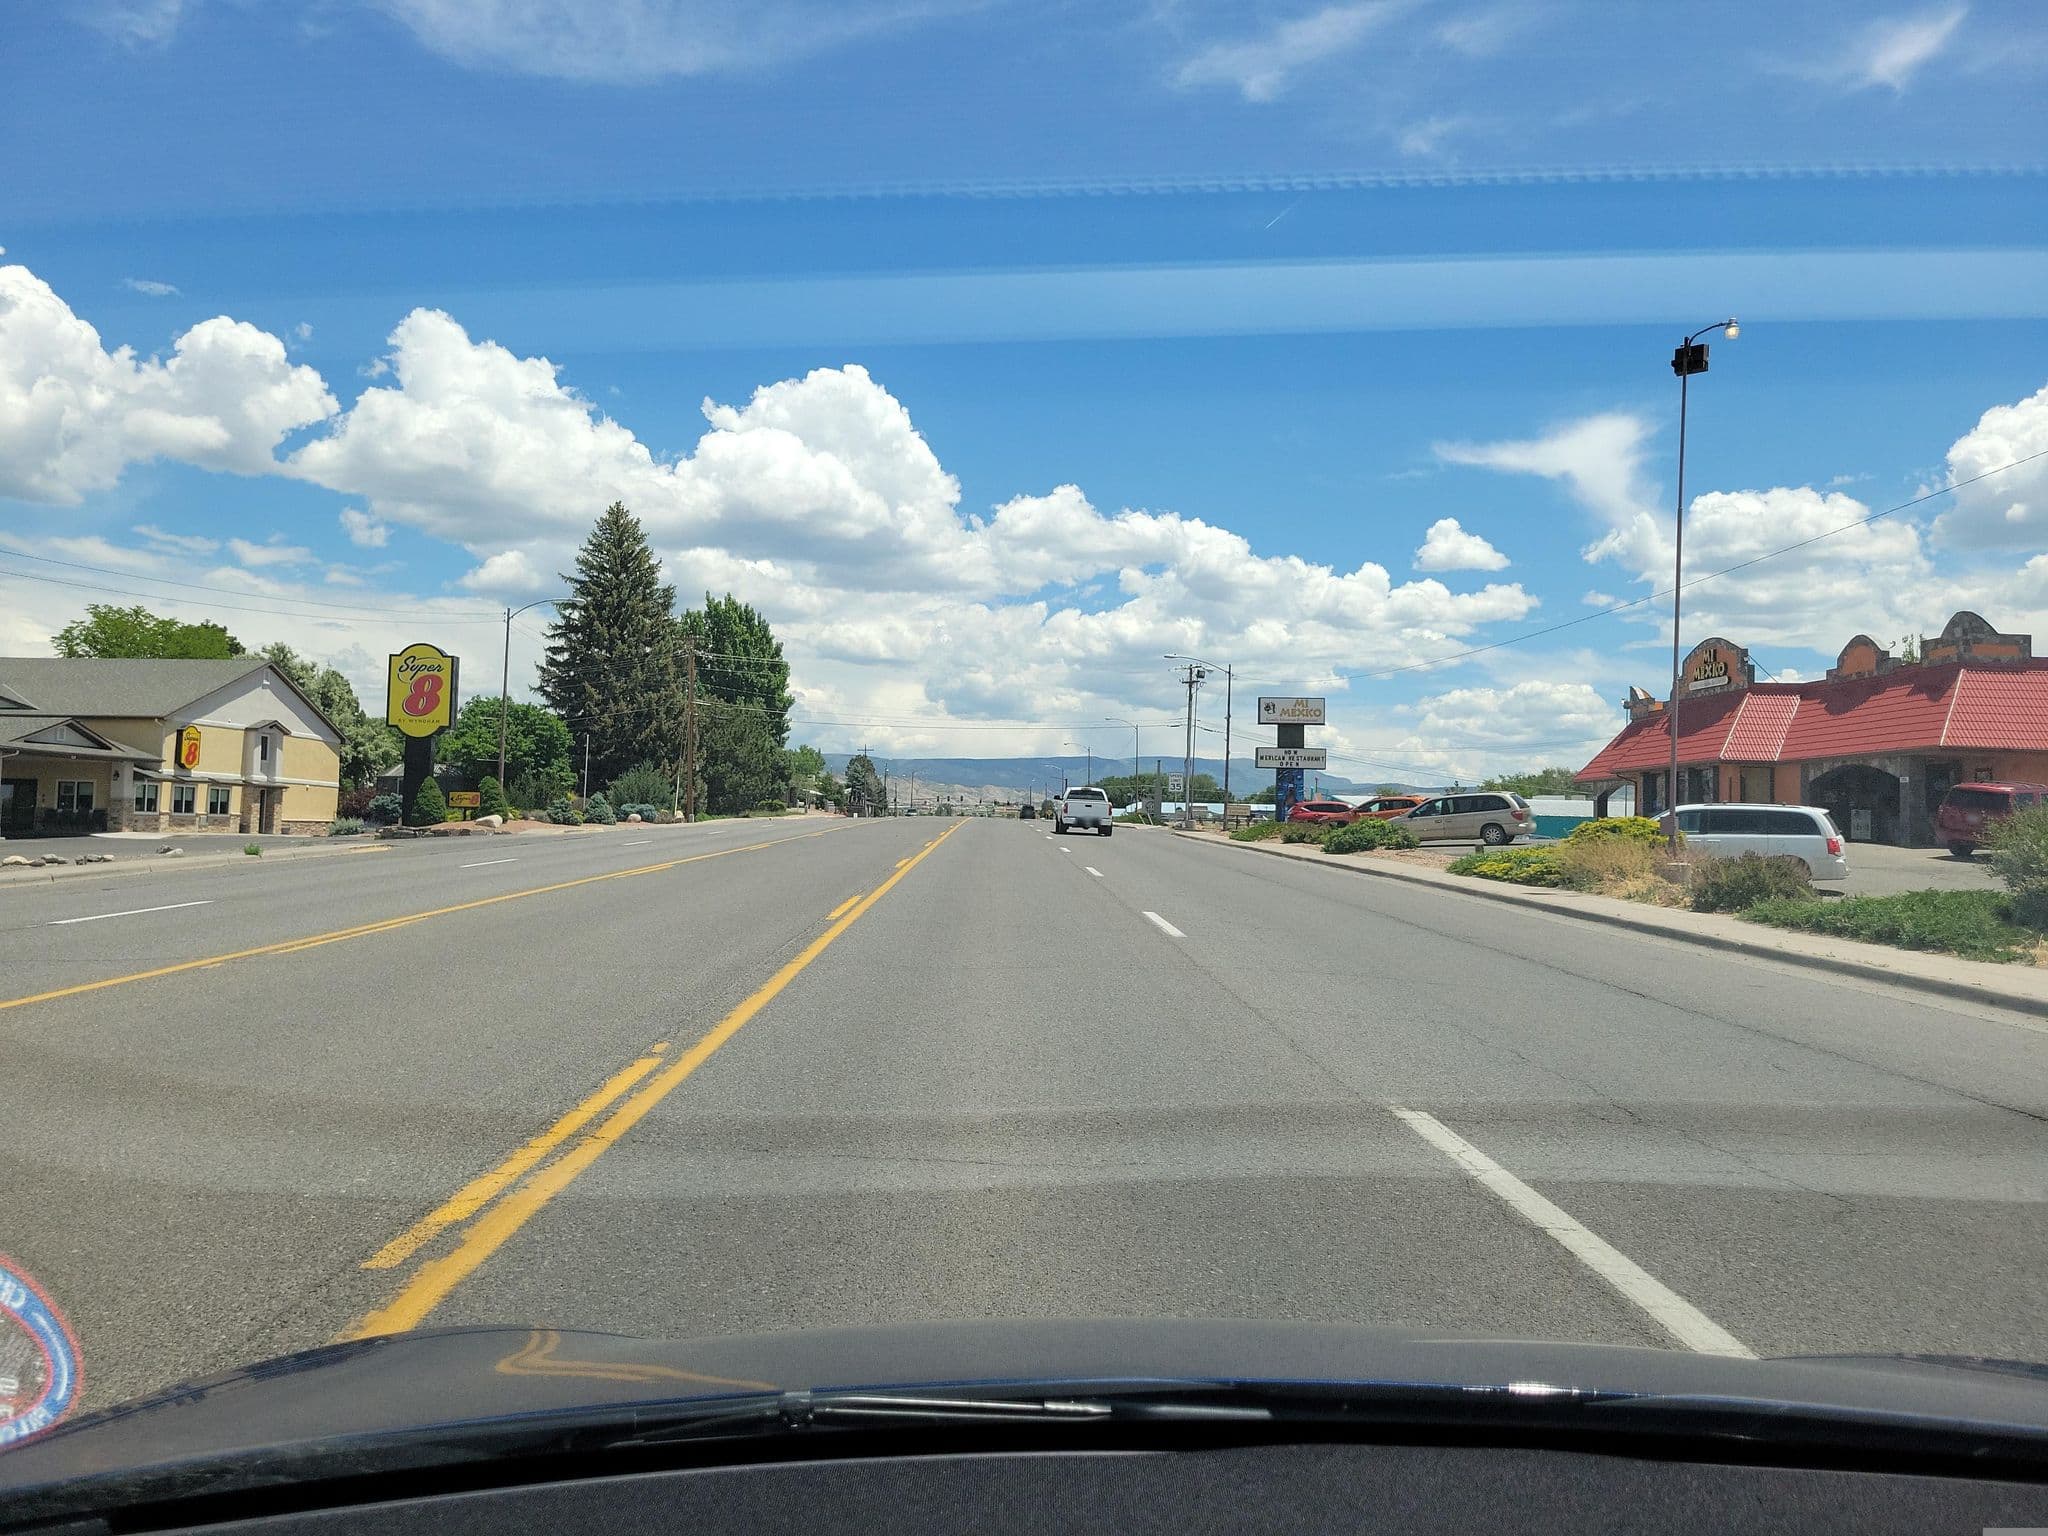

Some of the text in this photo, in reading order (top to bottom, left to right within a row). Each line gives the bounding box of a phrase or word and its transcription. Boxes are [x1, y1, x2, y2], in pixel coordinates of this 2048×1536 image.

[1703, 649, 1714, 662] MI
[398, 655, 445, 682] Super
[1693, 662, 1725, 680] MEXICO
[402, 674, 443, 716] 8
[1295, 699, 1308, 708] MI
[1280, 708, 1322, 717] MEXICO
[185, 742, 198, 765] 8
